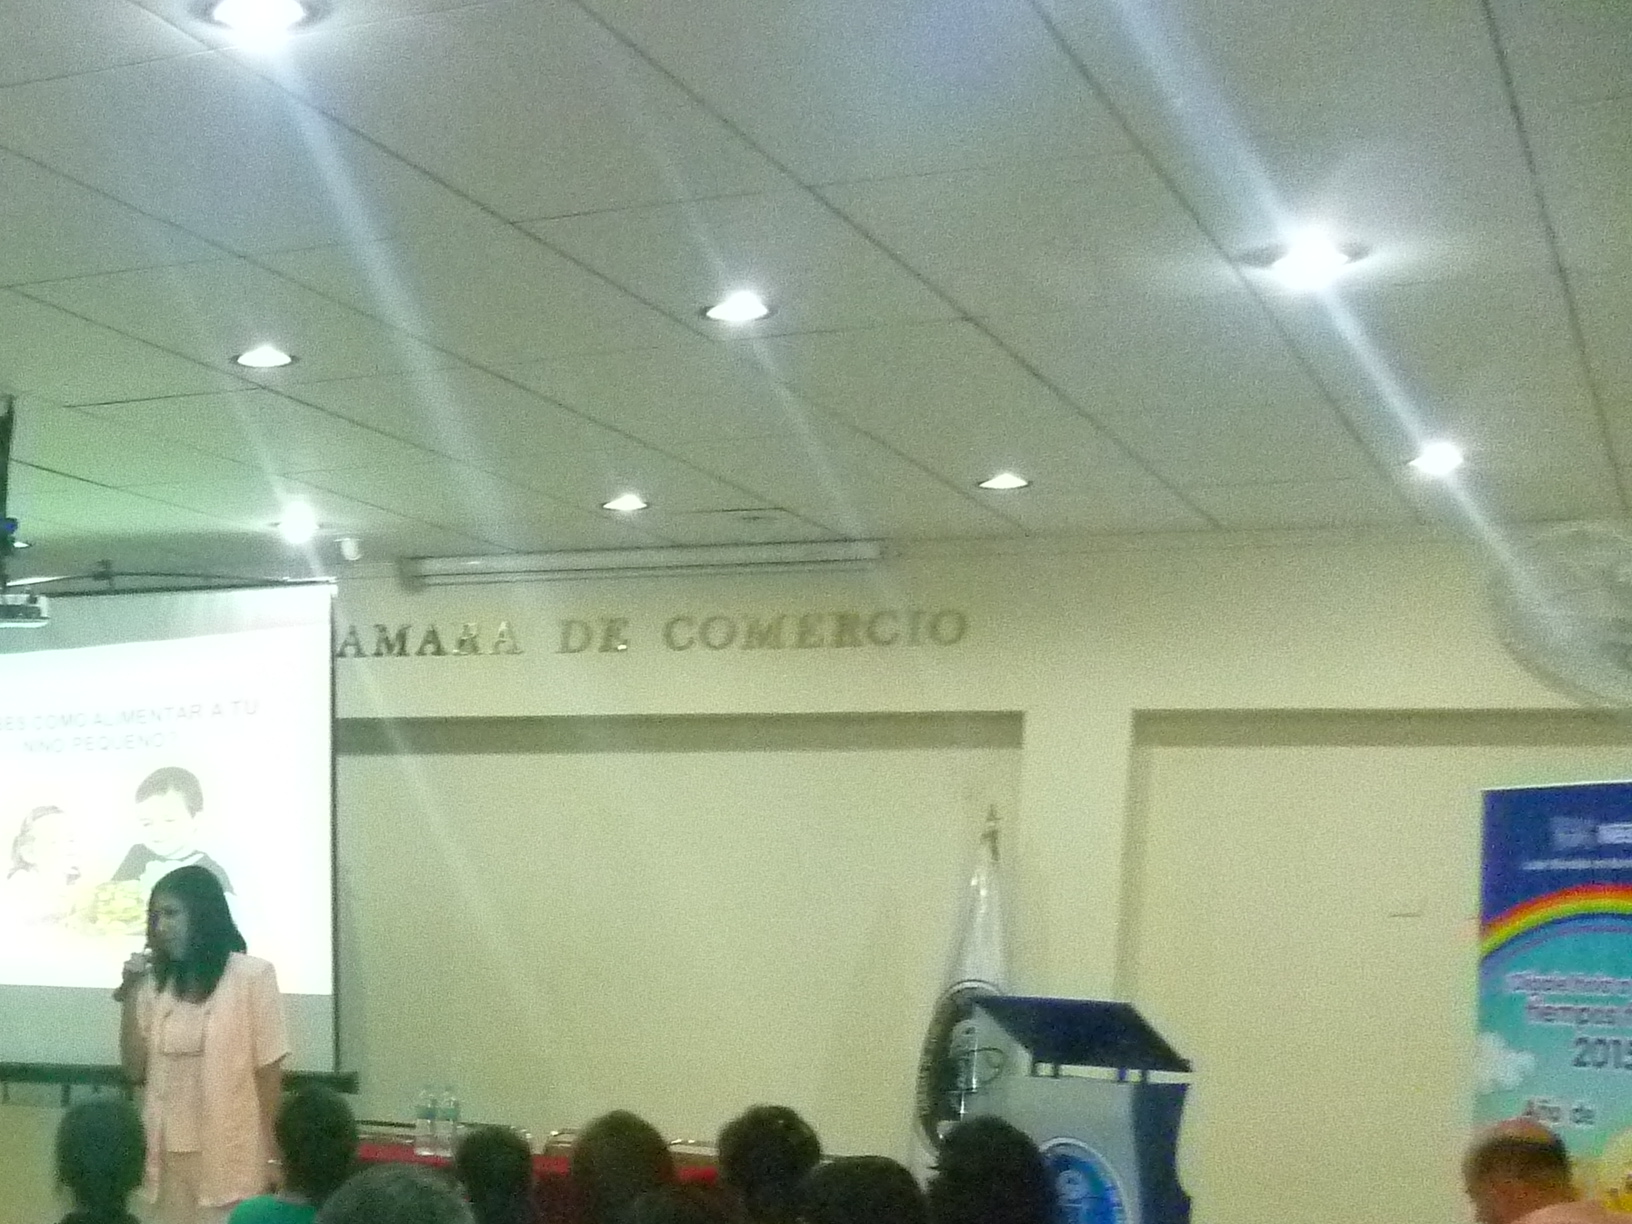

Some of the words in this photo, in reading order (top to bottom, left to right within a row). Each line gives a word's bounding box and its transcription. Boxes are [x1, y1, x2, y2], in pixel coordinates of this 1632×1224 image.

[335, 621, 525, 659] AMARA
[557, 617, 630, 656] DE
[662, 607, 970, 653] COMERCIO
